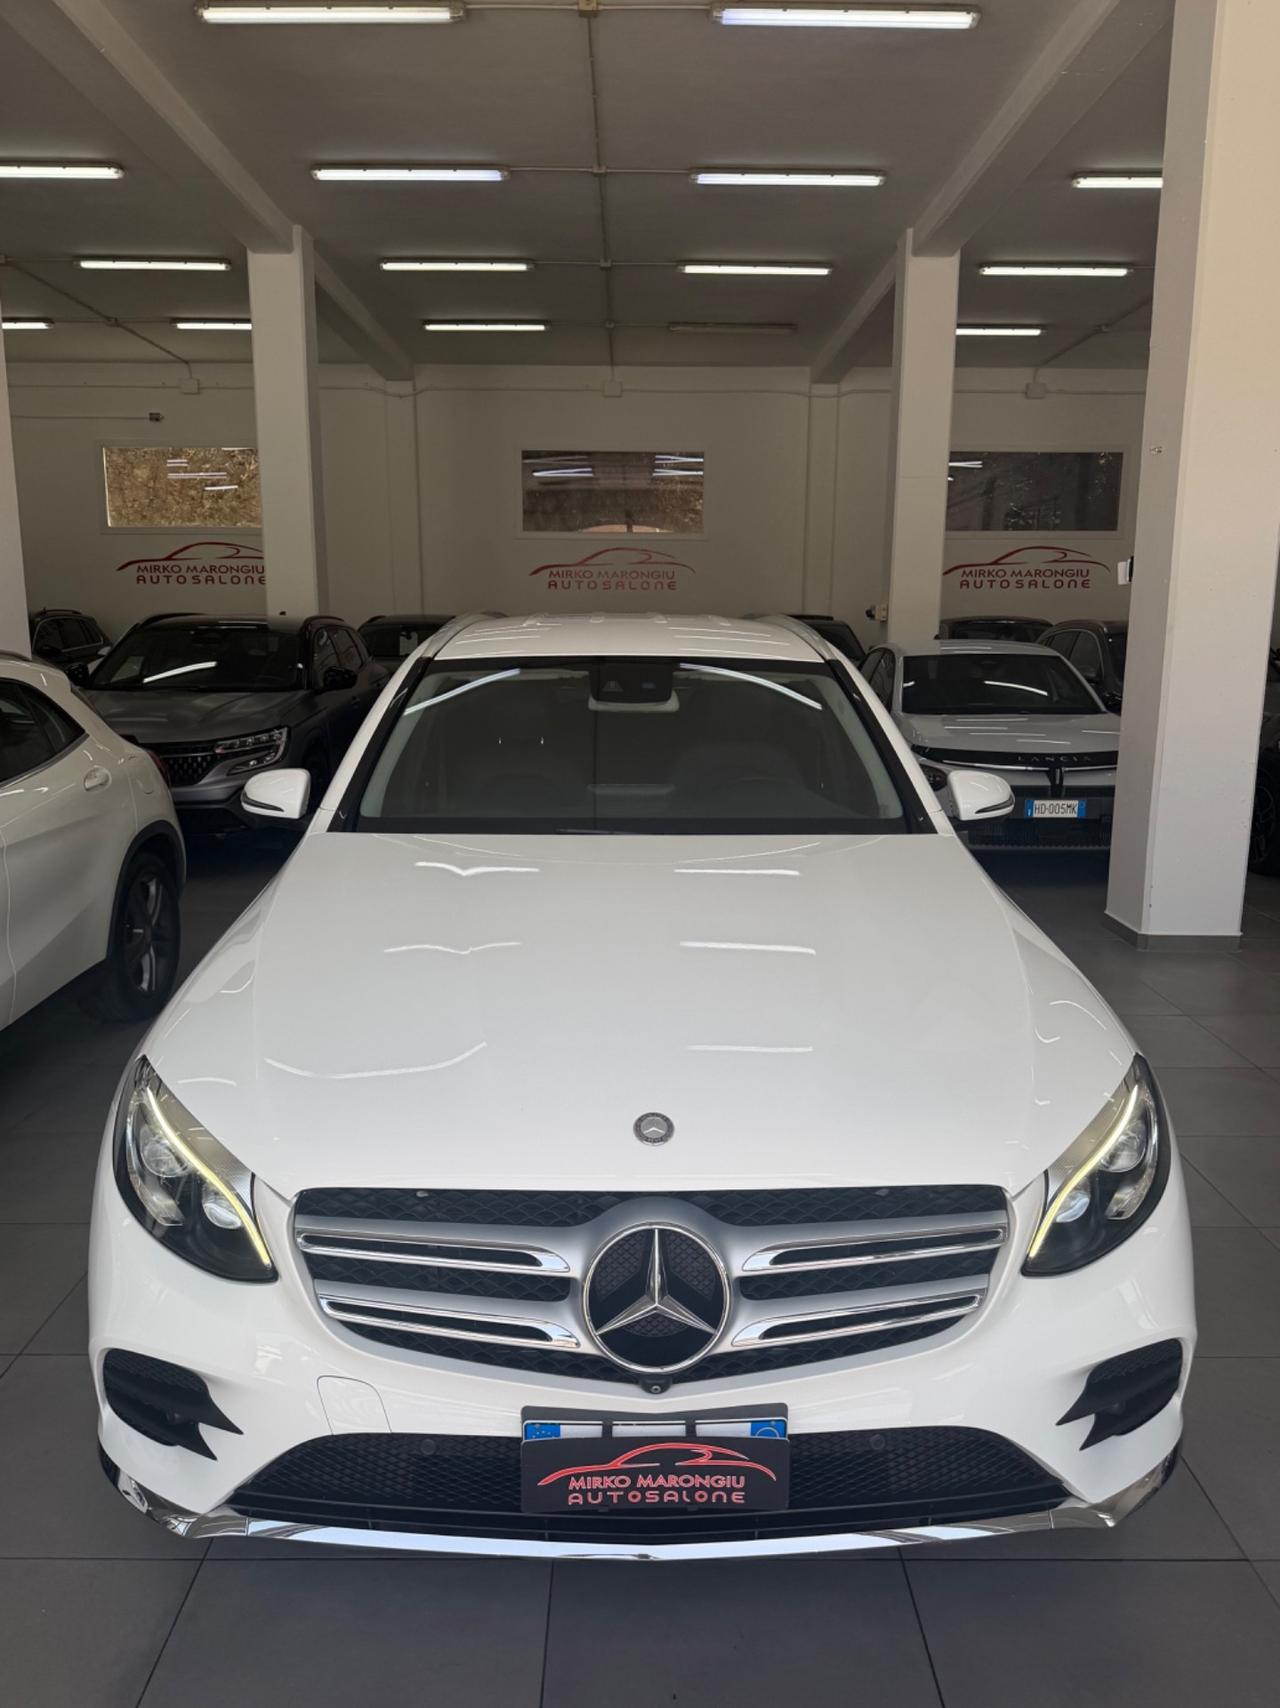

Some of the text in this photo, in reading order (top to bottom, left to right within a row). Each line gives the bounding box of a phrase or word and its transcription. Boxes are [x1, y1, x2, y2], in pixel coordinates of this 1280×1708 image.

[136, 564, 264, 574] MIRKO MARONGIU
[961, 568, 1090, 578] MIRKO MARONGIU
[548, 570, 675, 579] MIRKO MARONGIU
[136, 575, 266, 585] AUTOSALONE
[547, 580, 677, 590] AUTOSALONE
[960, 579, 1091, 589] AUTOSALONE
[568, 1474, 746, 1490] MIRKO MARONGIU
[568, 1490, 746, 1506] AUTOSALONE
